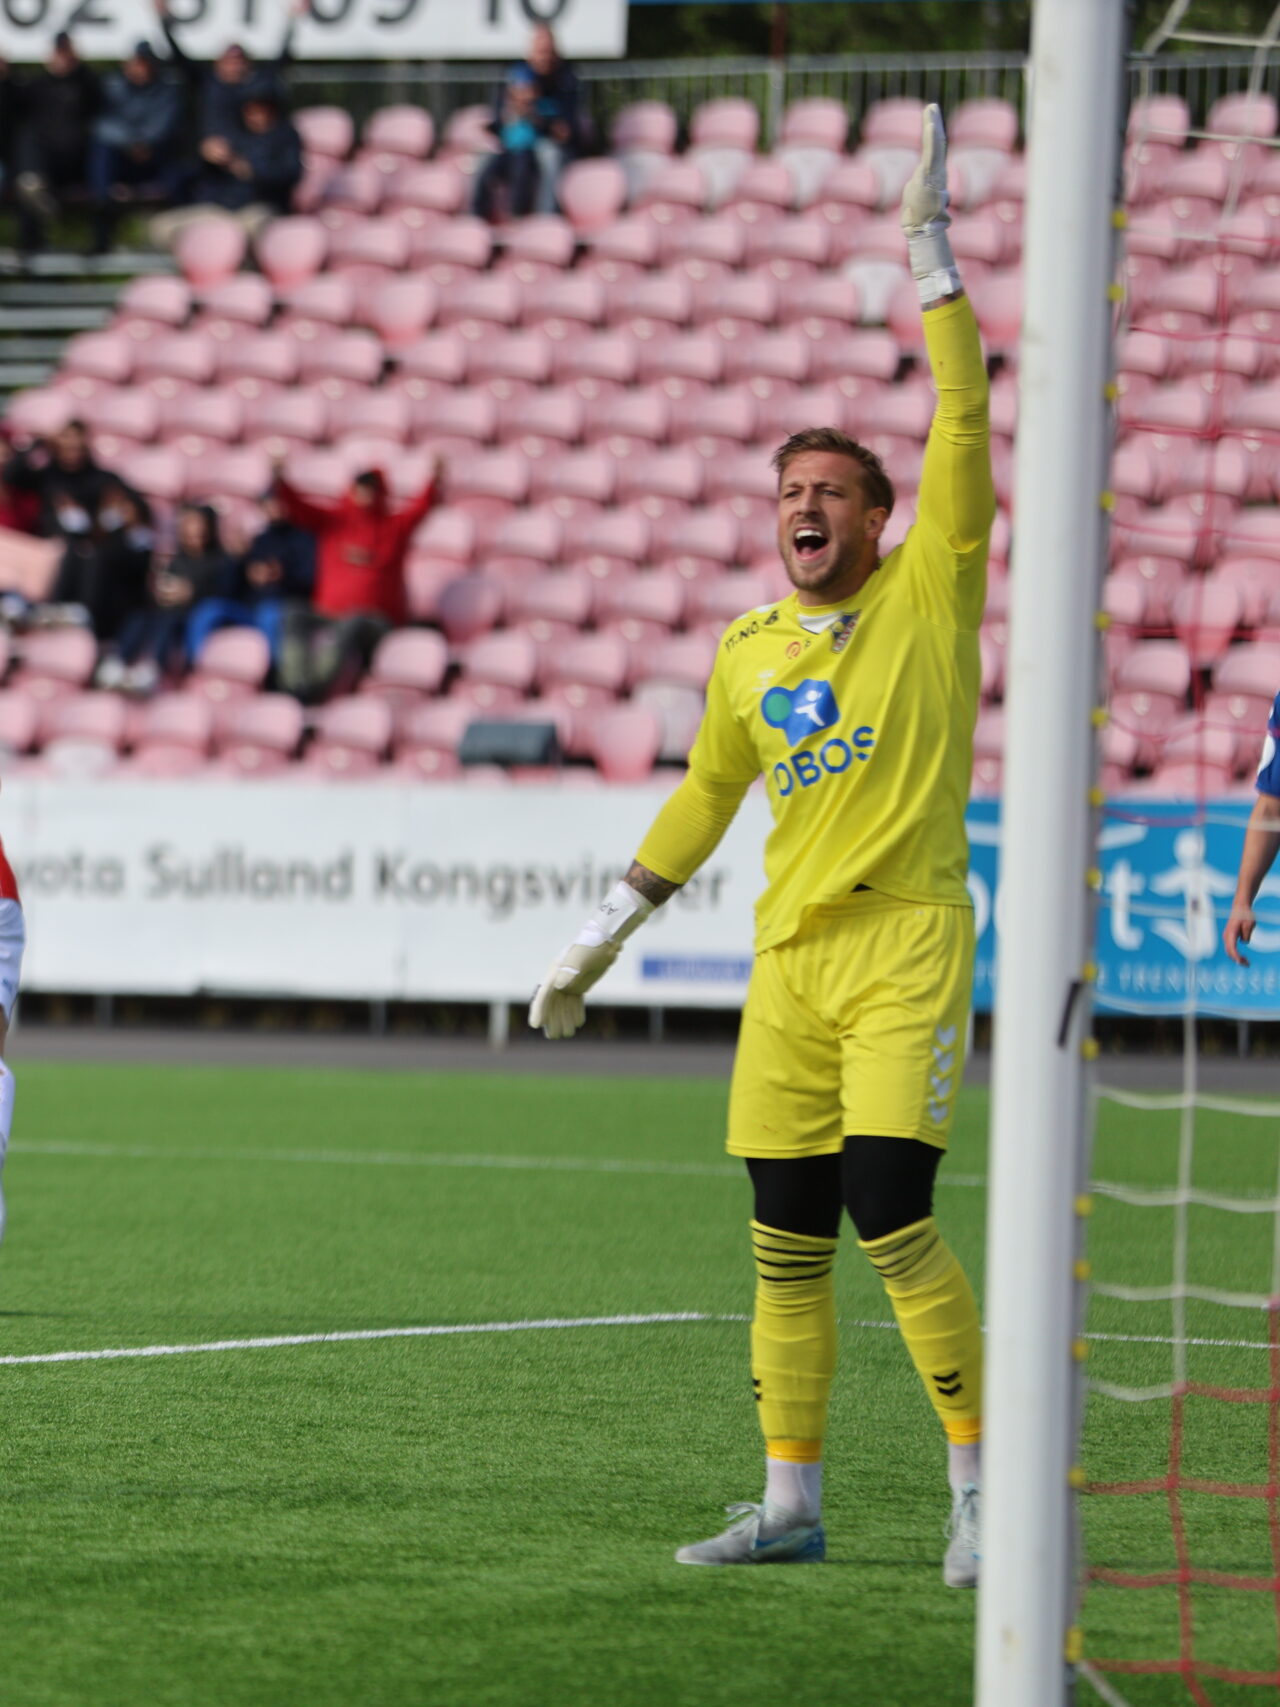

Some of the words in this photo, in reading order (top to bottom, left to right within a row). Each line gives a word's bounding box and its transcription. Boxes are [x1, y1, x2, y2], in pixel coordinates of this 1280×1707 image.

[773, 726, 875, 797] OBOS
[145, 844, 353, 899] Sulland
[374, 852, 728, 921] Kongsviner
